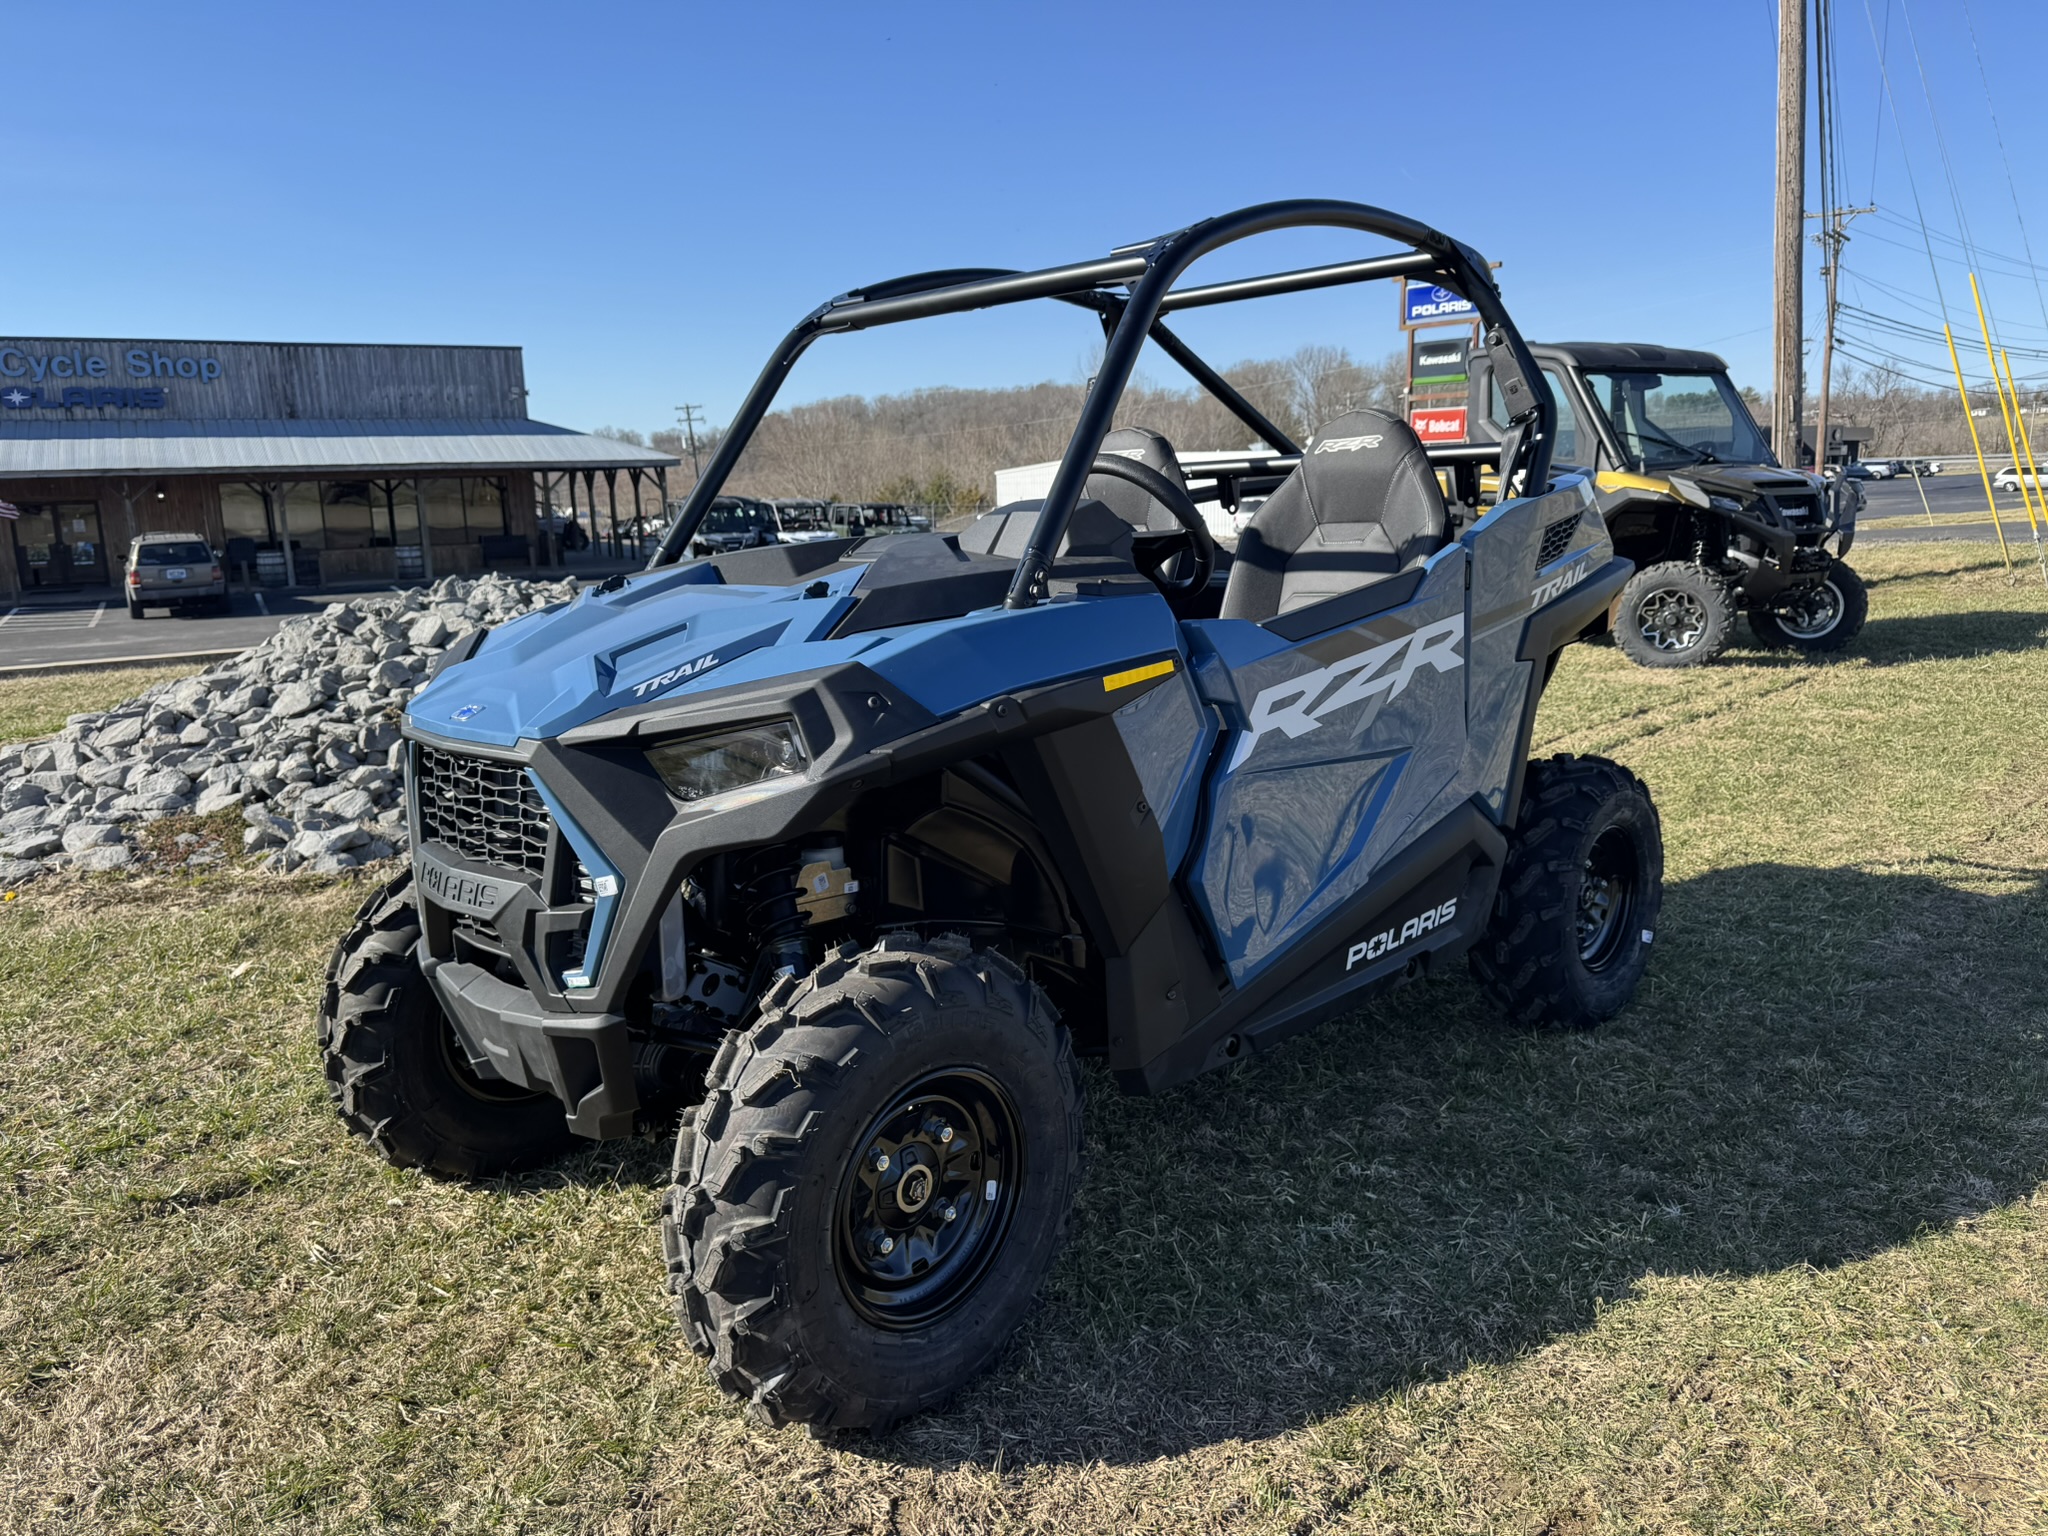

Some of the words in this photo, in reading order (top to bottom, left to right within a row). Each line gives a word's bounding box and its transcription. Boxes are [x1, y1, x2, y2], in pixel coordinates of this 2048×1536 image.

[1412, 300, 1472, 317] POLARIS
[0, 348, 108, 382] Cycle
[126, 349, 222, 384] Shop
[1419, 352, 1461, 366] Kawasaki
[0, 386, 165, 409] OLARIS
[1428, 419, 1460, 433] Bobcat
[1314, 435, 1383, 455] RZR
[1531, 561, 1588, 609] TRAIL
[632, 654, 719, 697] TRAIL
[1227, 612, 1464, 774] RZR
[1346, 897, 1457, 971] POLARIS
